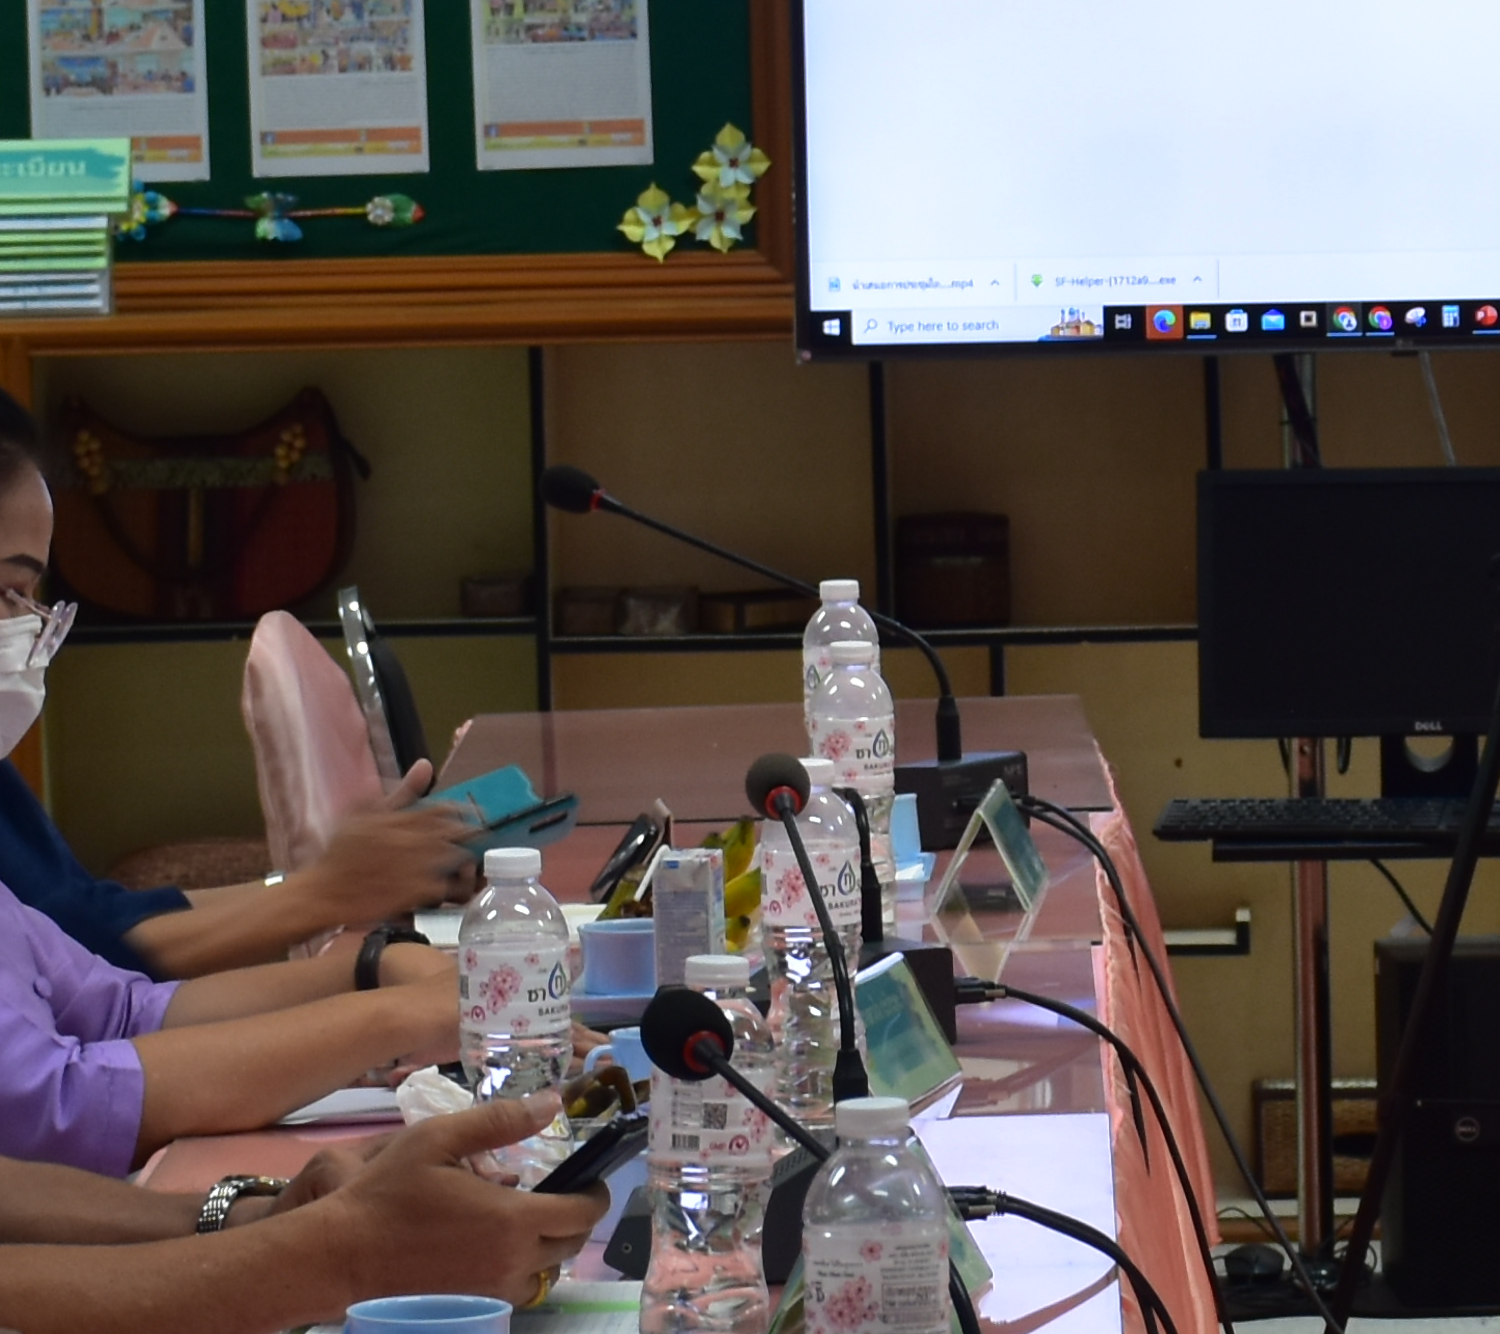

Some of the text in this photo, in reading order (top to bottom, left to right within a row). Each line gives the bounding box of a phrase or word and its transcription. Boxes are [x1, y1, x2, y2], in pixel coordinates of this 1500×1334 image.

[887, 319, 999, 334] Type here to search
[1414, 720, 1444, 732] DELL
